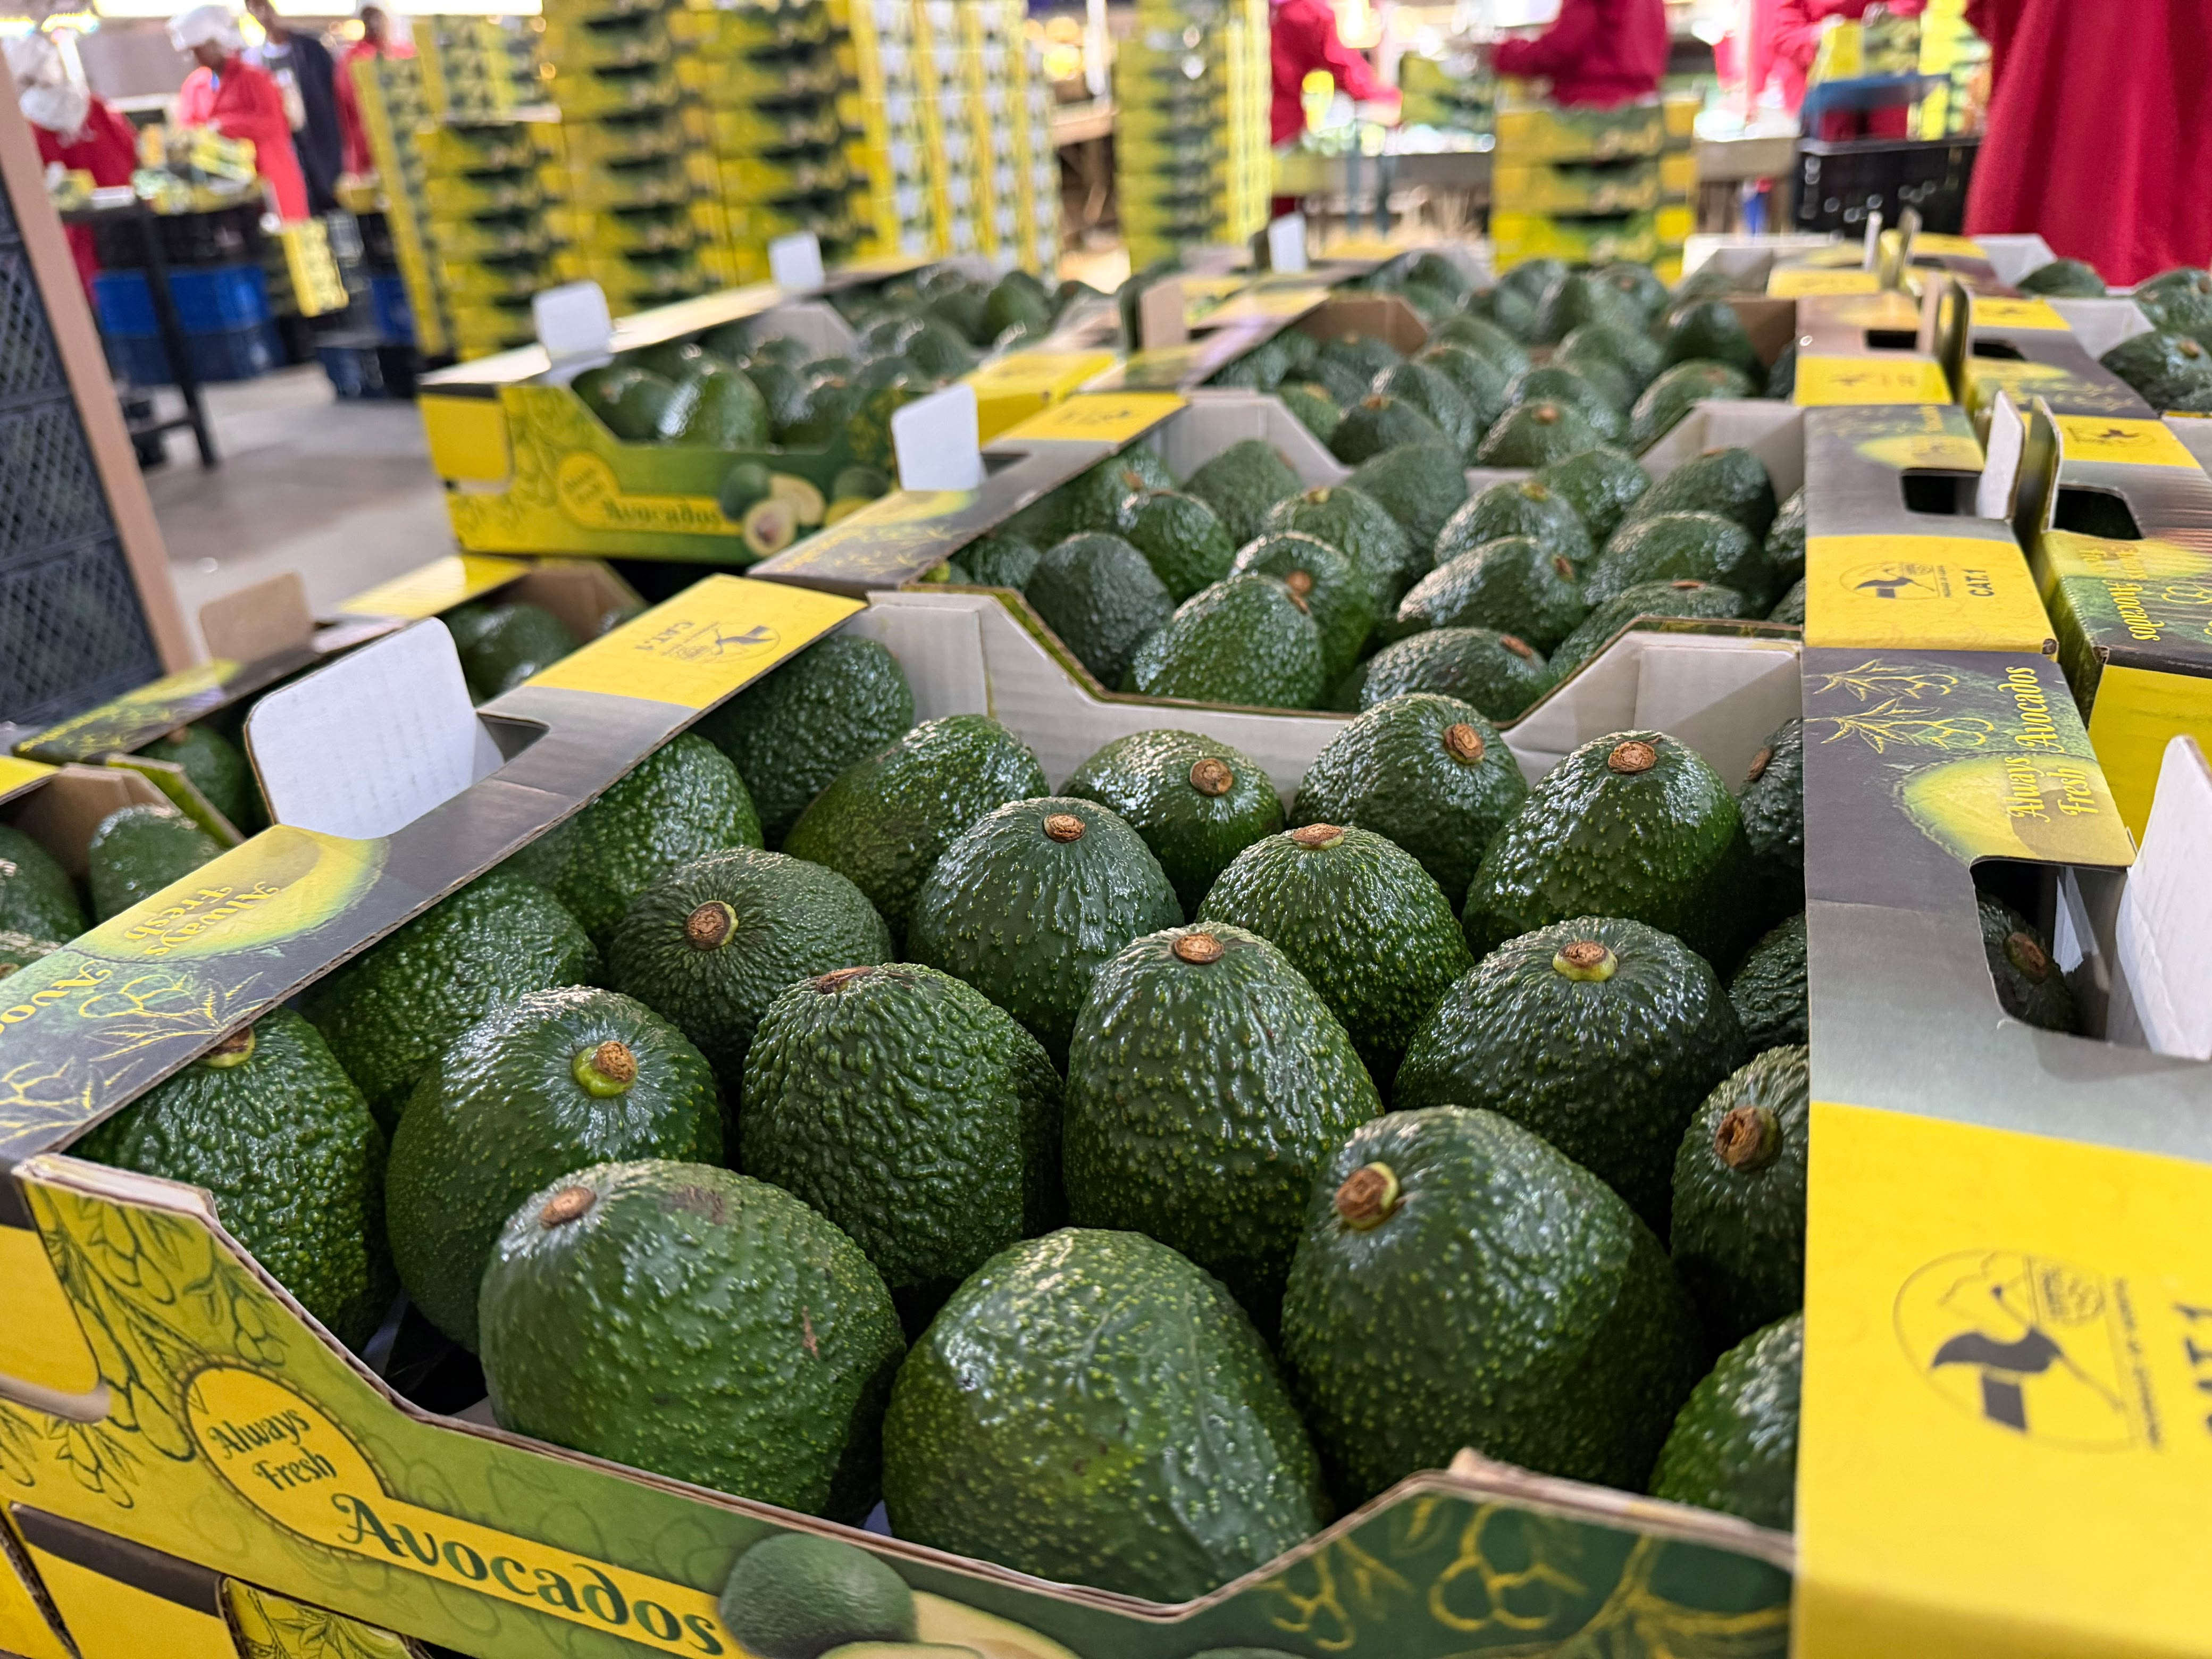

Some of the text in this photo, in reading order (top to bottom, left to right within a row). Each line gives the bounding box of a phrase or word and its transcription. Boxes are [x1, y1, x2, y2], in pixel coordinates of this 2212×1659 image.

[2101, 580, 2165, 641] Avocados
[1997, 667, 2065, 753] Avocados
[2002, 757, 2051, 823] Always
[2046, 768, 2099, 816] Fresh
[123, 886, 233, 940] Fresh
[143, 881, 280, 956] Always
[0, 960, 112, 1035] Avo
[207, 1409, 311, 1460] Always
[252, 1446, 338, 1491] Fresh
[331, 1493, 725, 1656] Avocados
